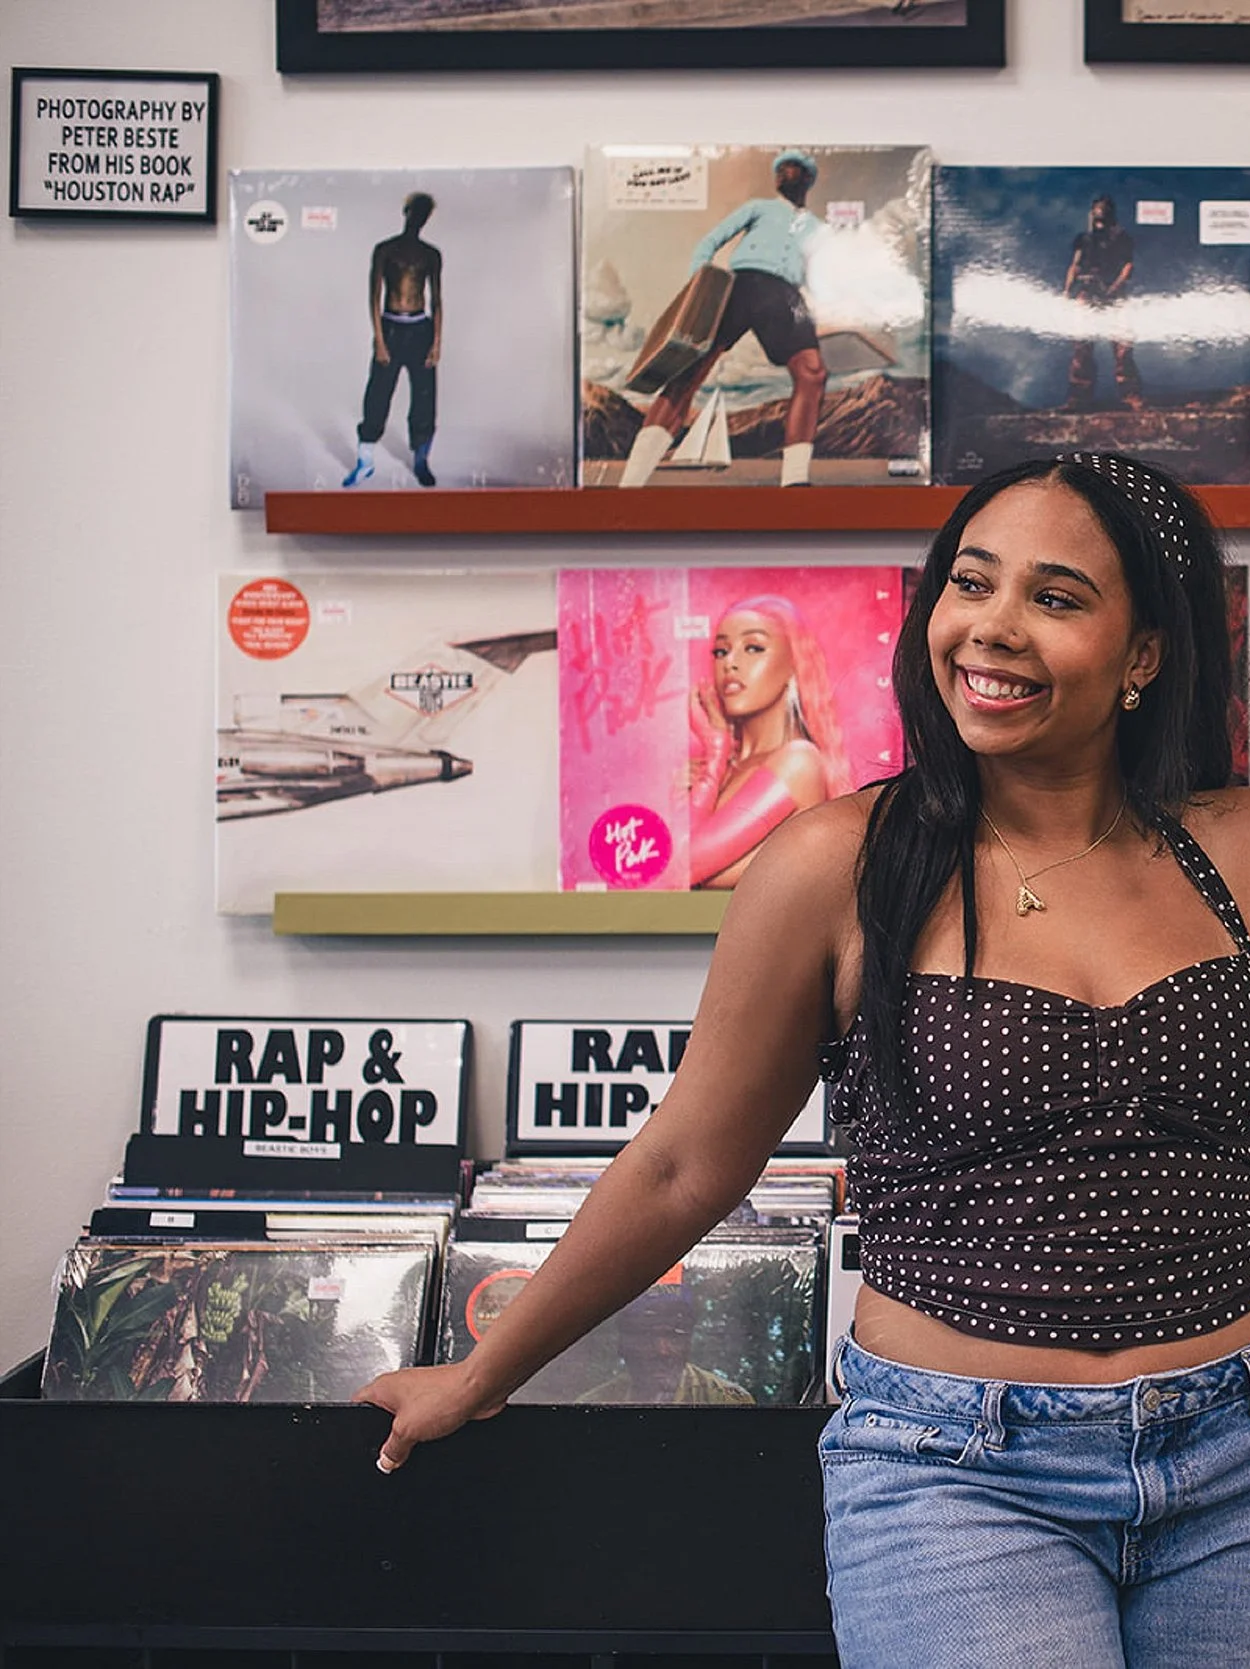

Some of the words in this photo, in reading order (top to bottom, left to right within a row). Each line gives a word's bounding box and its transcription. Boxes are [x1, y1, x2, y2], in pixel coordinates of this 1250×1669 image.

[36, 98, 177, 121] PHOTOGRAPHY
[181, 101, 206, 122] BY
[62, 126, 118, 148] PETER
[123, 127, 179, 149] BESTE
[48, 152, 100, 175] FROM
[105, 154, 135, 175] HIS
[140, 155, 192, 176] BOOK
[214, 1029, 345, 1084] RAP
[362, 1028, 405, 1084] &
[177, 1089, 438, 1144] HIP-HOP
